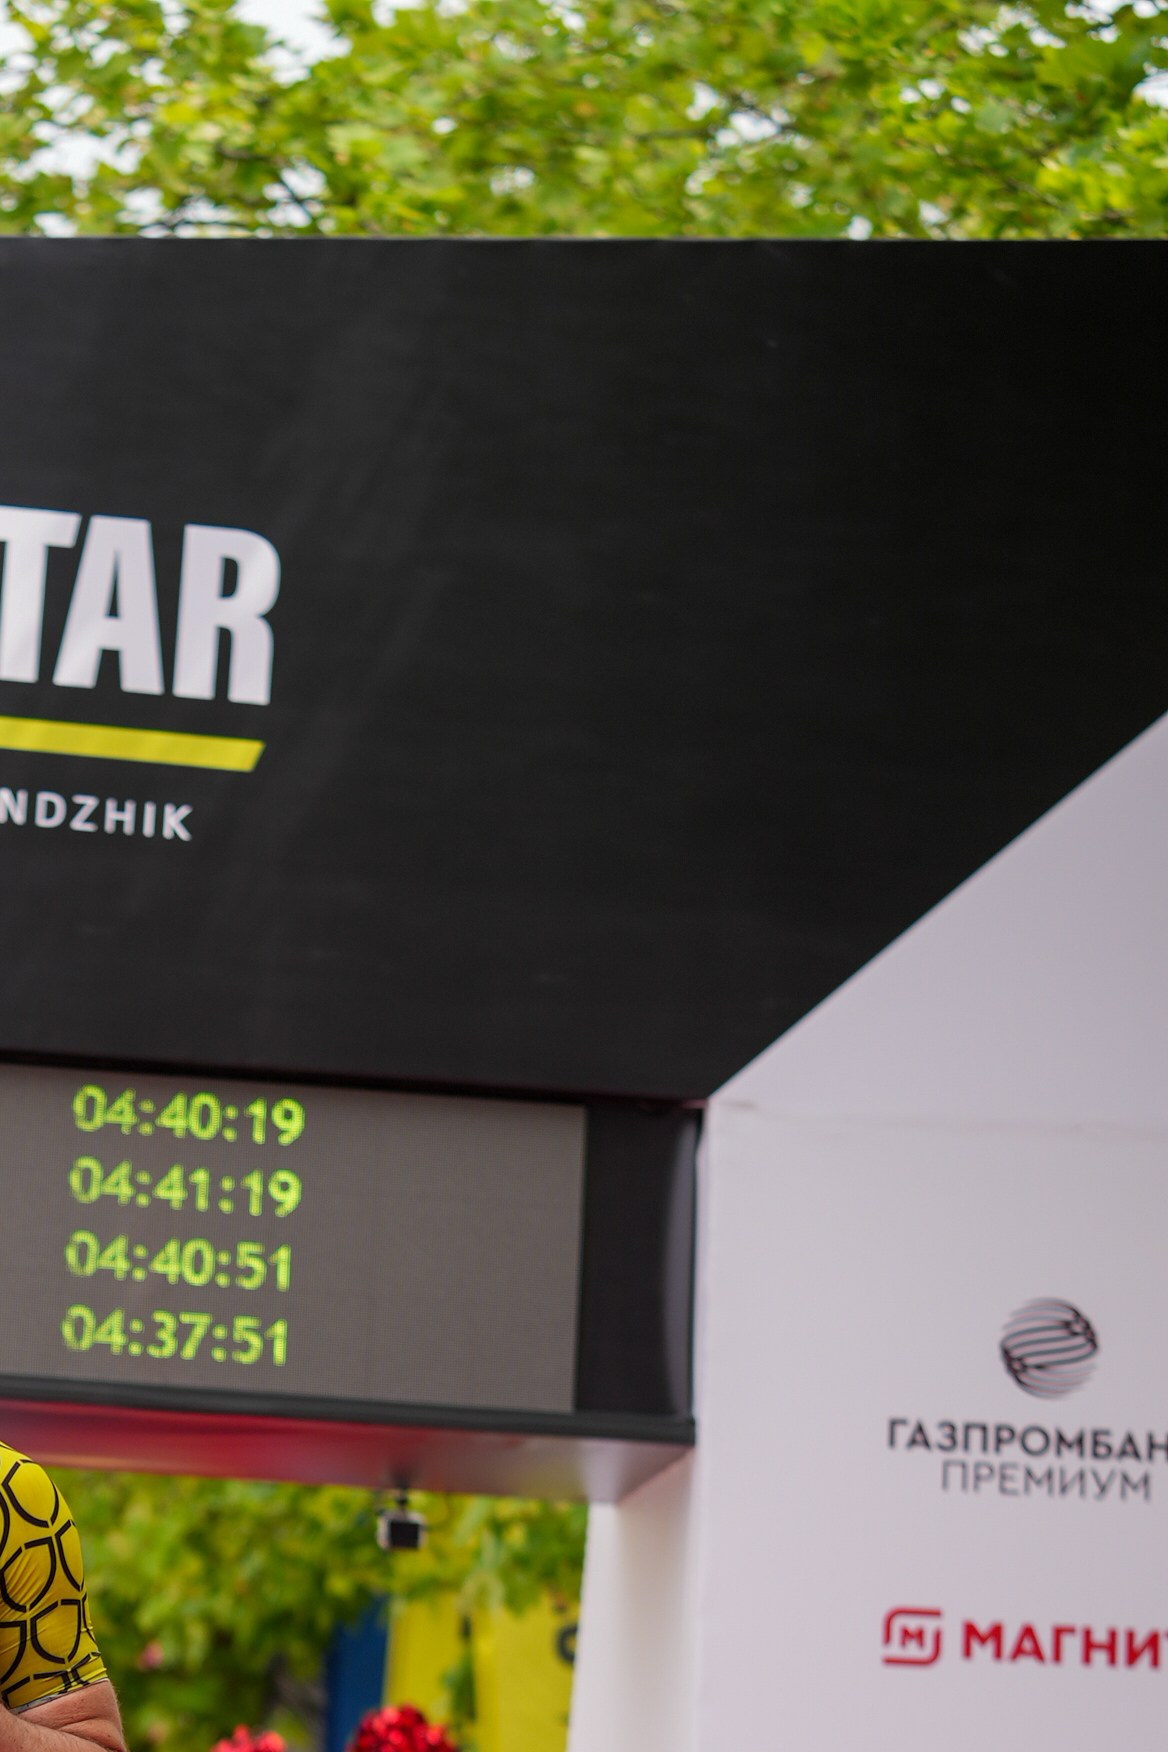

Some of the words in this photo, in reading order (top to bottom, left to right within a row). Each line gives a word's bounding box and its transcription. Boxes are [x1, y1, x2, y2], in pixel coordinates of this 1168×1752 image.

[72, 1083, 306, 1147] 04:40:19
[68, 1155, 303, 1218] 04:41:19
[64, 1229, 293, 1293] 04:40:51
[60, 1303, 289, 1367] 04:37:51
[942, 1458, 1152, 1502] ПРЕМИУМ
[962, 1619, 1168, 1670] МАГНИ
